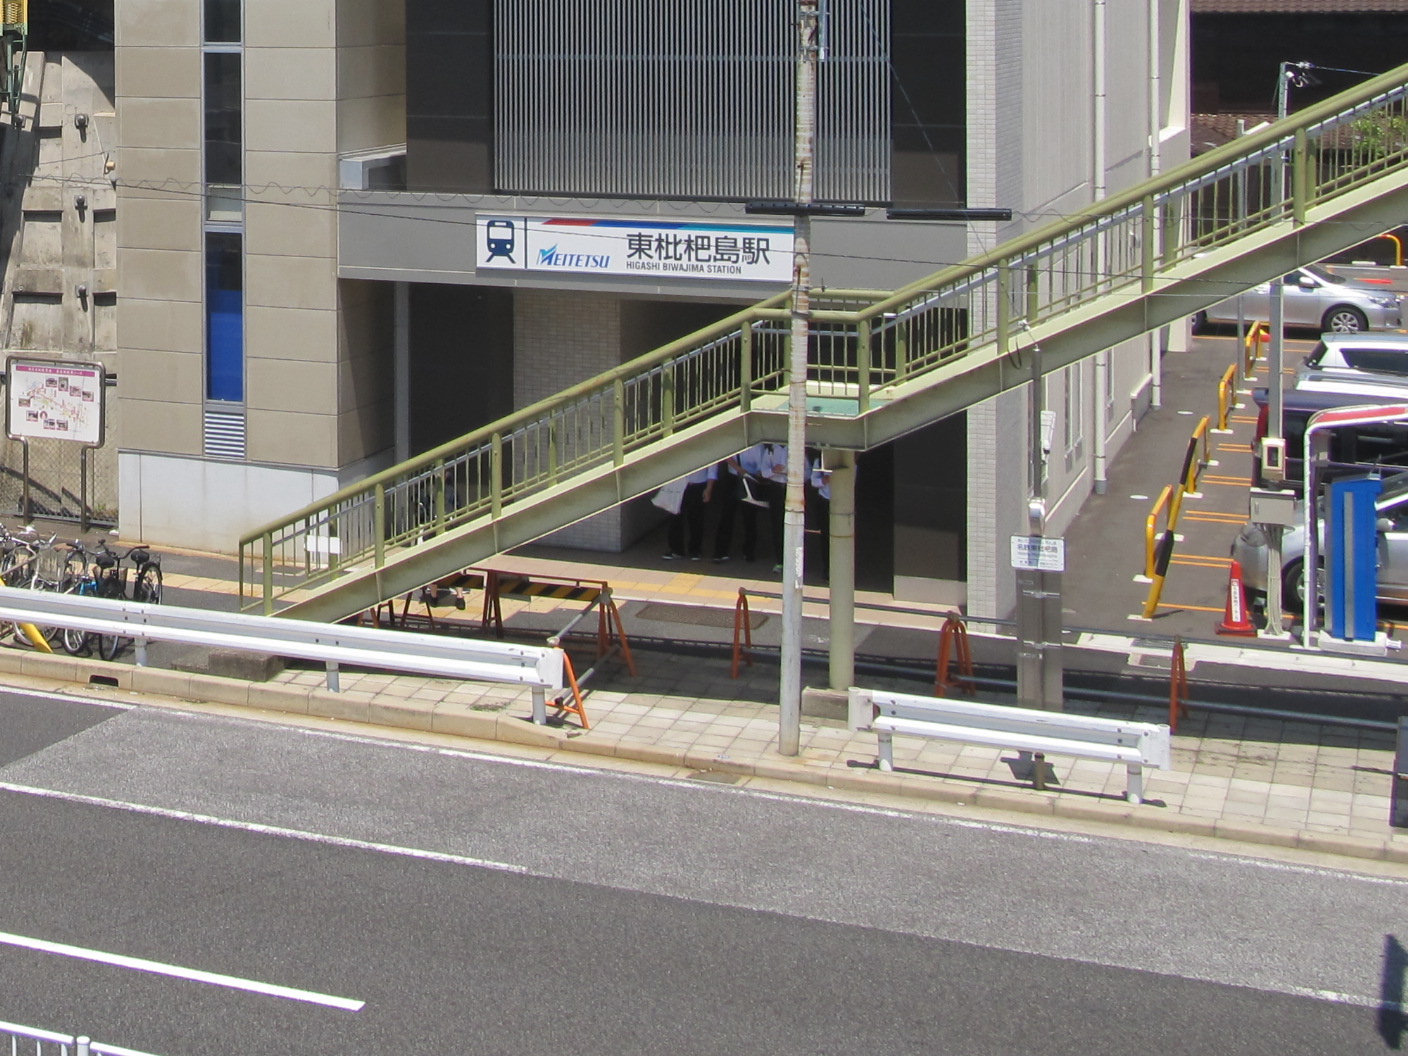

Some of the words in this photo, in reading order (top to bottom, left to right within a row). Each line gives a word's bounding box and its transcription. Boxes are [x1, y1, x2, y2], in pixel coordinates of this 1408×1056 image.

[537, 243, 610, 269] MEITETSU
[626, 232, 770, 265] 東枇杷島駅
[626, 261, 660, 271] HIGASHI
[663, 262, 704, 273] BIWAJIMA
[707, 264, 742, 274] STATION
